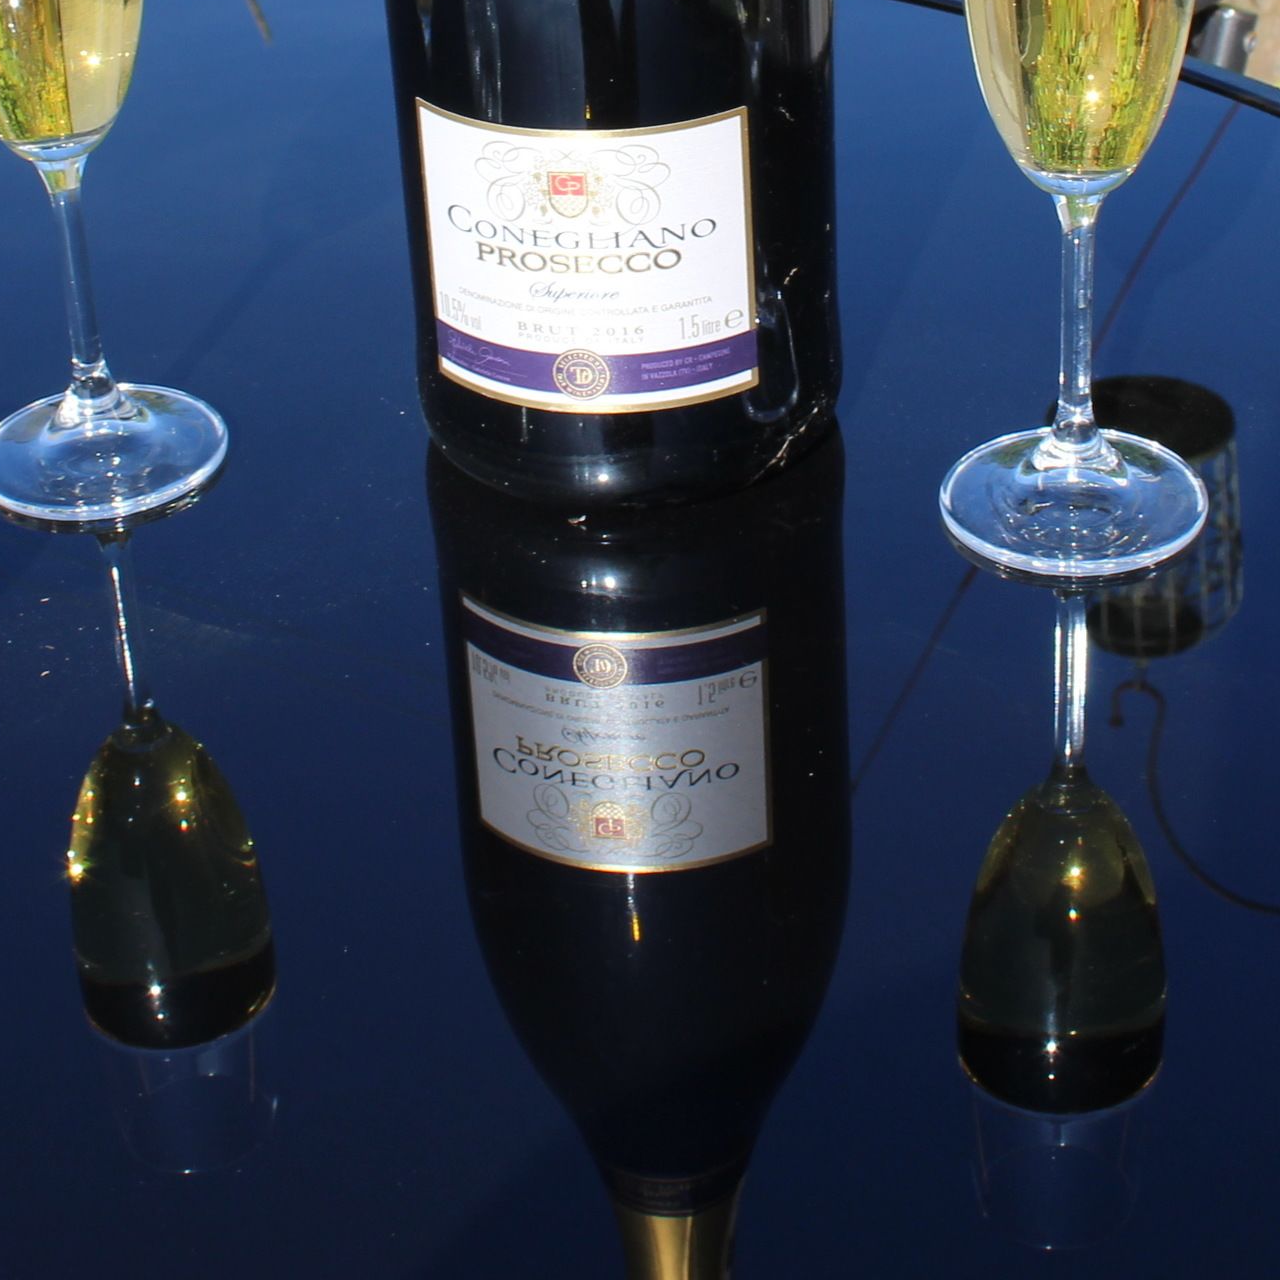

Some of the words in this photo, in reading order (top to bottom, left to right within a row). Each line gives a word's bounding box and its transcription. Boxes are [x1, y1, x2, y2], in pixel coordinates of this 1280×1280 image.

[476, 241, 682, 274] PROSECCO
[528, 280, 620, 303] Superiore
[661, 296, 713, 313] GARANTITA
[517, 321, 576, 336] BRUT
[592, 324, 645, 336] 2016
[680, 313, 700, 340] 1.5
